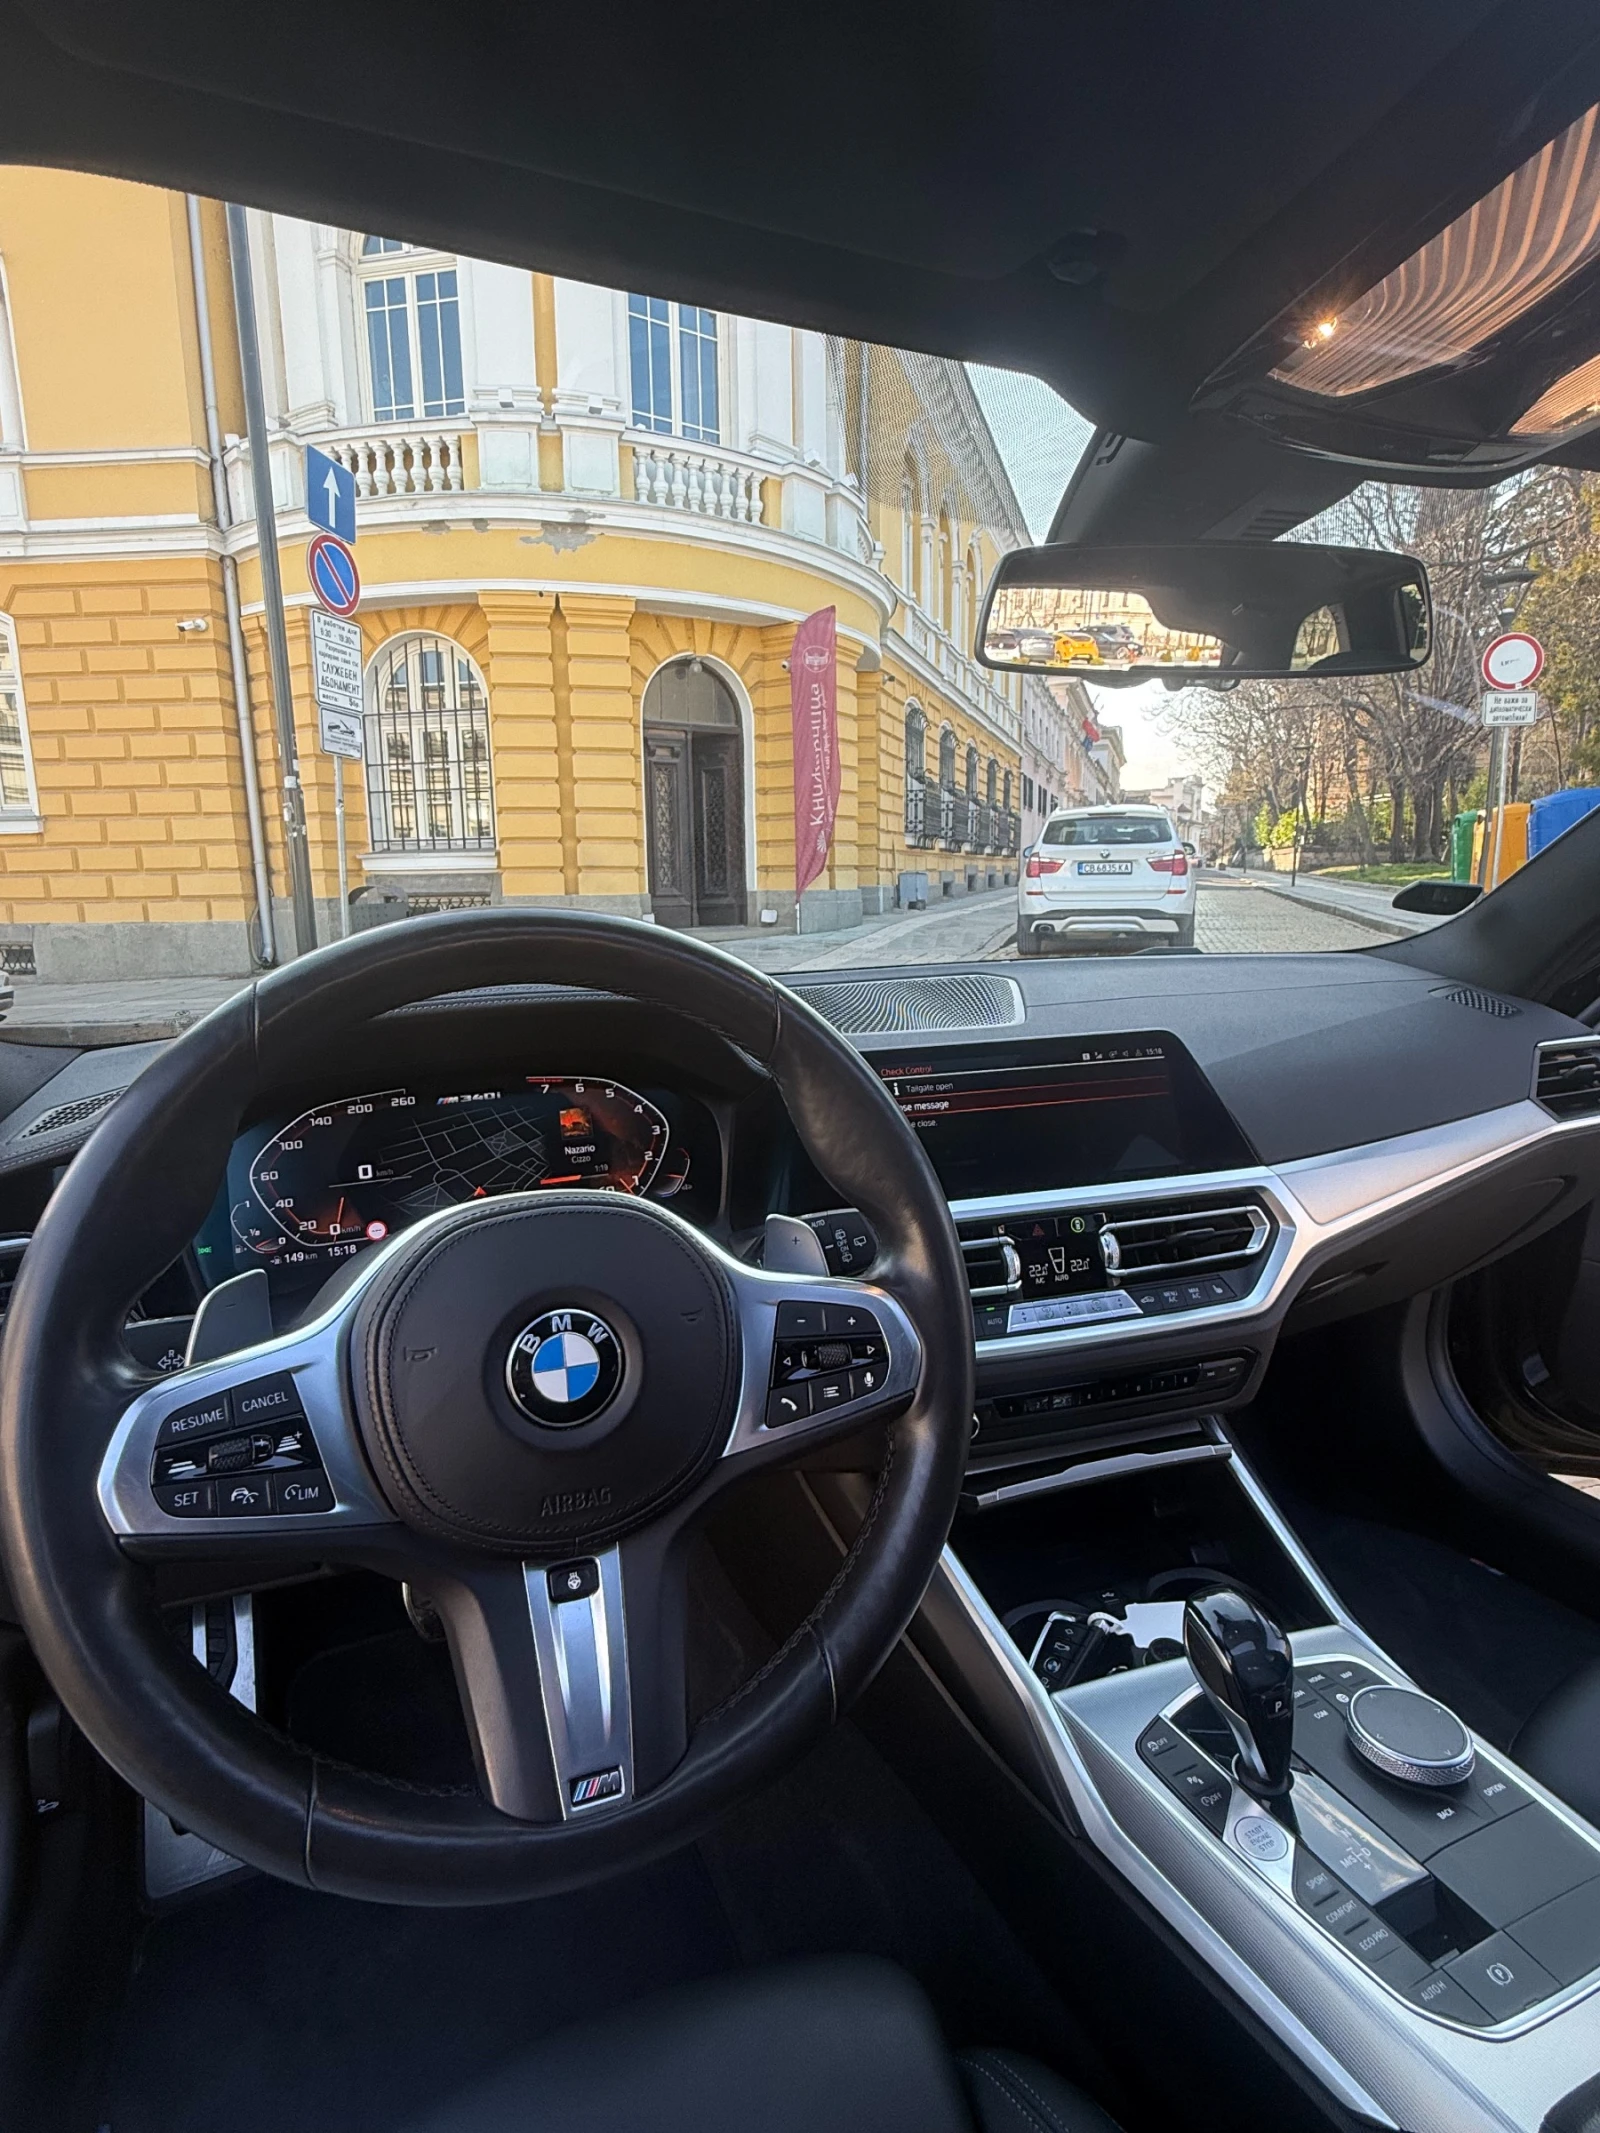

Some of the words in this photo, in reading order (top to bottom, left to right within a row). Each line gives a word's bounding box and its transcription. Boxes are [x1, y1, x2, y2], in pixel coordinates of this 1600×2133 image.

[321, 661, 358, 682] СЛУЖЕБЕН
[320, 675, 360, 696] АБОНАМЕНТ
[881, 1067, 904, 1076] Check
[905, 1065, 932, 1075] Control
[541, 1084, 550, 1094] 7
[575, 1083, 585, 1093] 6
[605, 1088, 615, 1098] 5
[905, 1084, 934, 1094] Tailgate
[935, 1082, 954, 1091] open
[391, 1096, 416, 1107] 260
[914, 1101, 949, 1112] message
[347, 1103, 373, 1114] 200
[634, 1105, 643, 1114] 4
[308, 1116, 332, 1126] 140
[652, 1125, 661, 1135] 3
[279, 1140, 303, 1150] 100
[564, 1144, 596, 1155] Nazario
[571, 1155, 591, 1164] Cizzo
[644, 1151, 653, 1161] 2
[260, 1170, 279, 1181] 60
[358, 1164, 373, 1180] 0
[632, 1175, 640, 1186] 1
[275, 1198, 294, 1208] 40
[299, 1220, 318, 1231] 20
[811, 1219, 826, 1228] AUTO
[329, 1224, 341, 1236] 0
[341, 1226, 361, 1235] km/h
[278, 1237, 286, 1245] 0
[328, 1245, 357, 1257] 15:18
[284, 1252, 304, 1264] 149
[305, 1252, 318, 1261] km
[519, 1314, 608, 1355] BMW
[241, 1391, 289, 1413] CANCEL
[171, 1408, 225, 1433] RESUME
[298, 1486, 319, 1500] LIM
[174, 1491, 199, 1507] SET
[541, 1487, 612, 1518] AIRBAG
[1275, 1701, 1282, 1713] P
[1314, 1709, 1329, 1720] COM
[1483, 1783, 1507, 1796] OPTION
[1436, 1807, 1456, 1820] BACK
[1244, 1825, 1264, 1839] START
[1250, 1832, 1273, 1846] ENGINE
[1259, 1840, 1275, 1851] STOP
[1305, 1872, 1329, 1890] SPORT
[1325, 1900, 1357, 1924] COMFORT
[1359, 1936, 1376, 1951] ECO
[1373, 1929, 1389, 1944] PRO
[1421, 1984, 1441, 2001] AUTO
